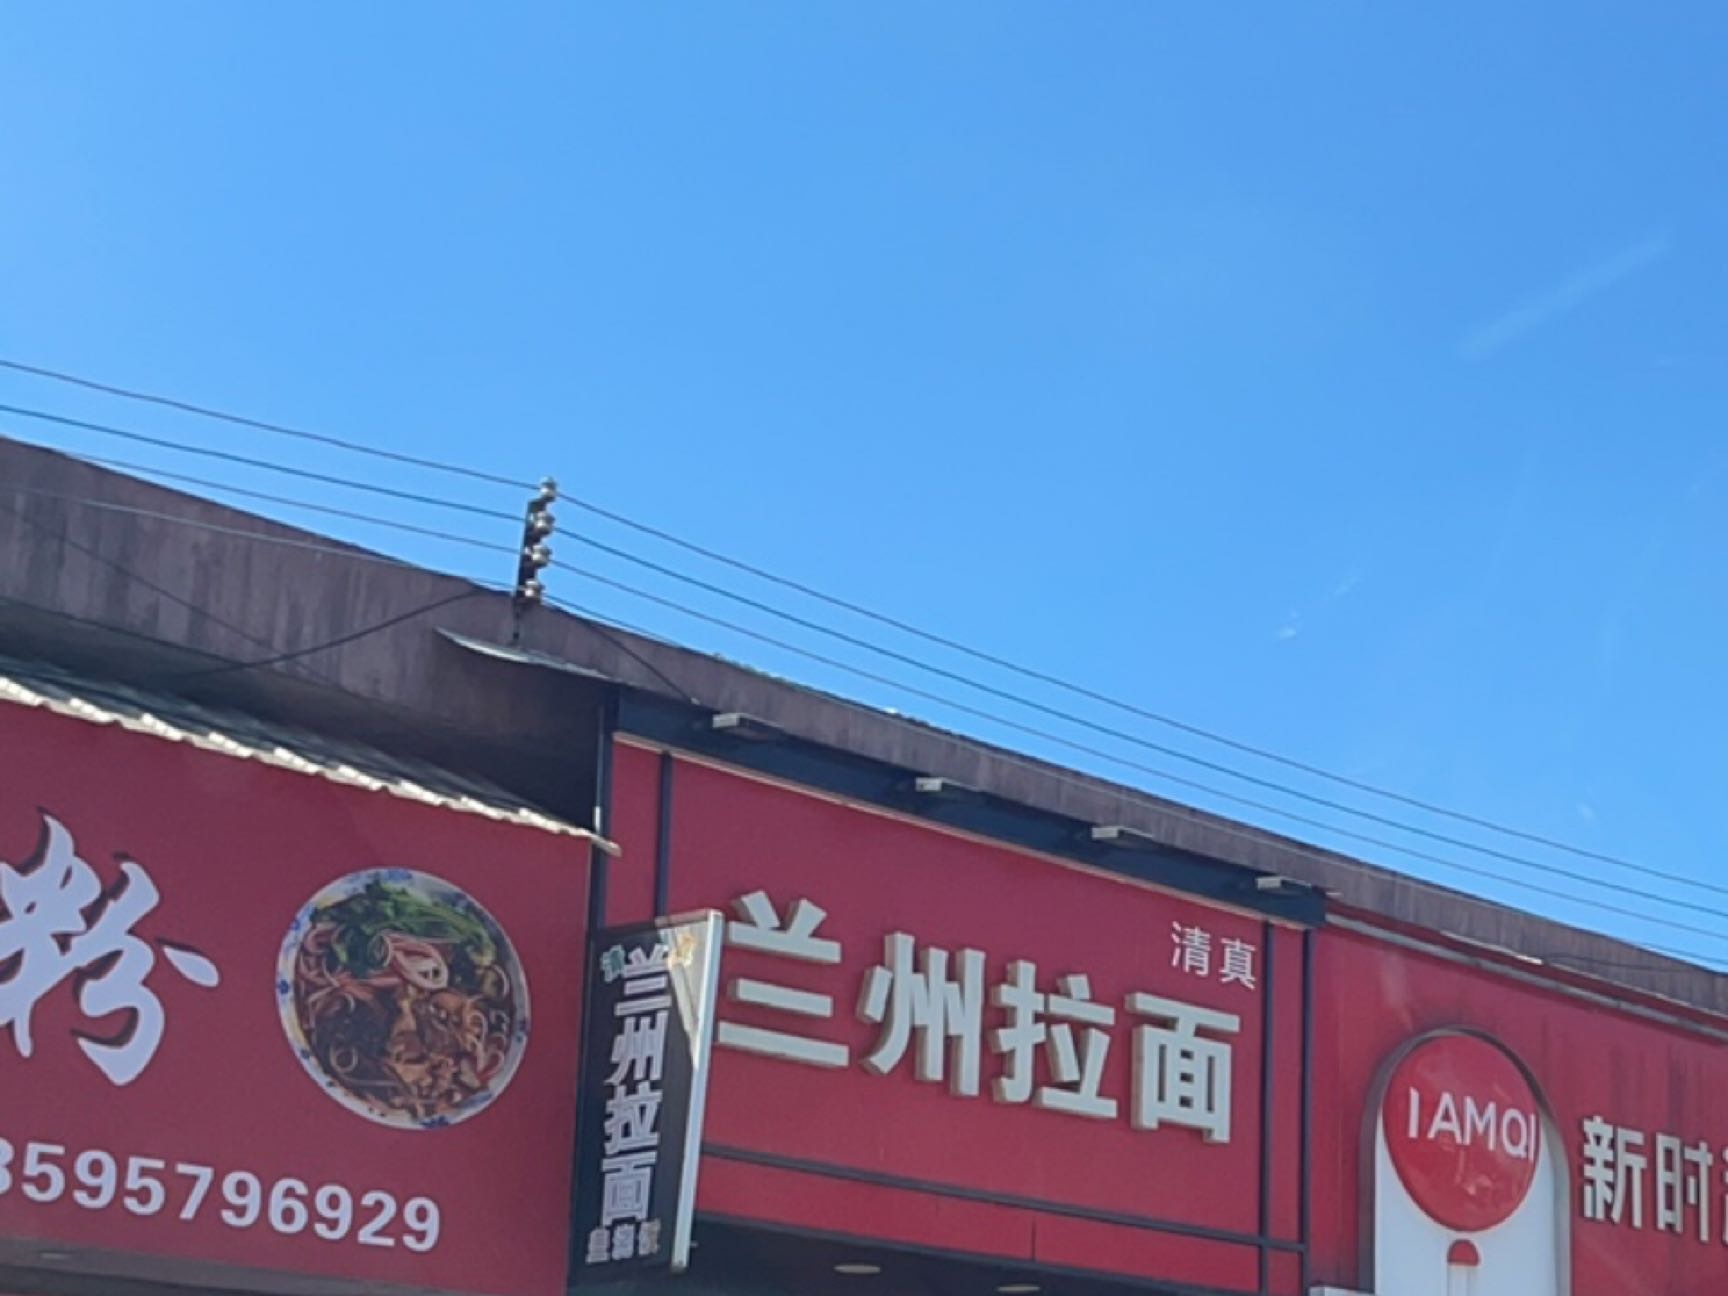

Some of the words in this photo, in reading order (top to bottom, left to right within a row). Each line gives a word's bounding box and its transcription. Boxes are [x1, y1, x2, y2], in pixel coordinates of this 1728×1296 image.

[717, 891, 1241, 1144] 兰州拉面
[1171, 921, 1257, 989] 清真
[602, 943, 672, 1226] 兰州拉面
